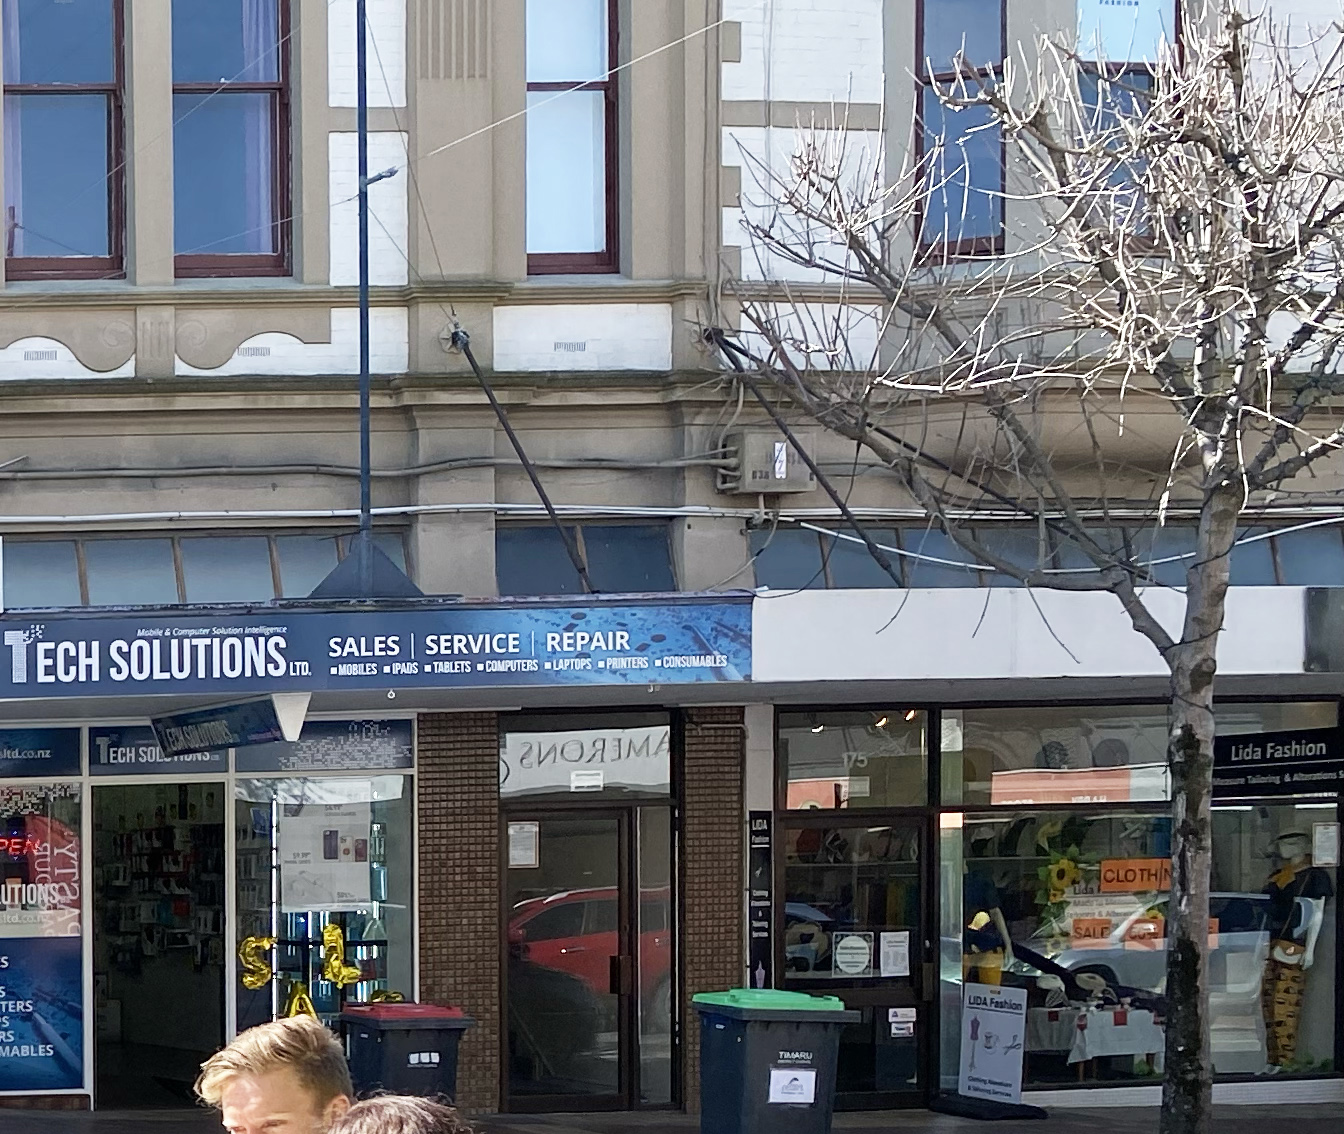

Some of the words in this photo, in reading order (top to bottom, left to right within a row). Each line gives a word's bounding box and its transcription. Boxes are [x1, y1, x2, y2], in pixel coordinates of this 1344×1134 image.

[172, 627, 211, 638] Computer
[211, 626, 244, 635] Solution
[328, 634, 400, 658] SALES
[425, 632, 520, 656] SERVICE
[546, 630, 631, 652] REPAIR
[4, 628, 101, 684] TECH
[109, 635, 288, 682] SOLUTIONS
[338, 663, 378, 676] MOBILES
[391, 662, 419, 675] IPADS
[433, 660, 472, 674] TABLETS
[485, 659, 539, 673] COMPUTERS
[553, 658, 592, 671] LAPTOPS
[607, 656, 649, 670] PRINTERS
[662, 655, 728, 669] CONSUMABLES
[842, 751, 869, 768] 175
[1230, 743, 1262, 762] Lida
[1265, 739, 1327, 759] Fashion
[968, 994, 989, 1008] LIDA
[989, 997, 1023, 1012] Fashion
